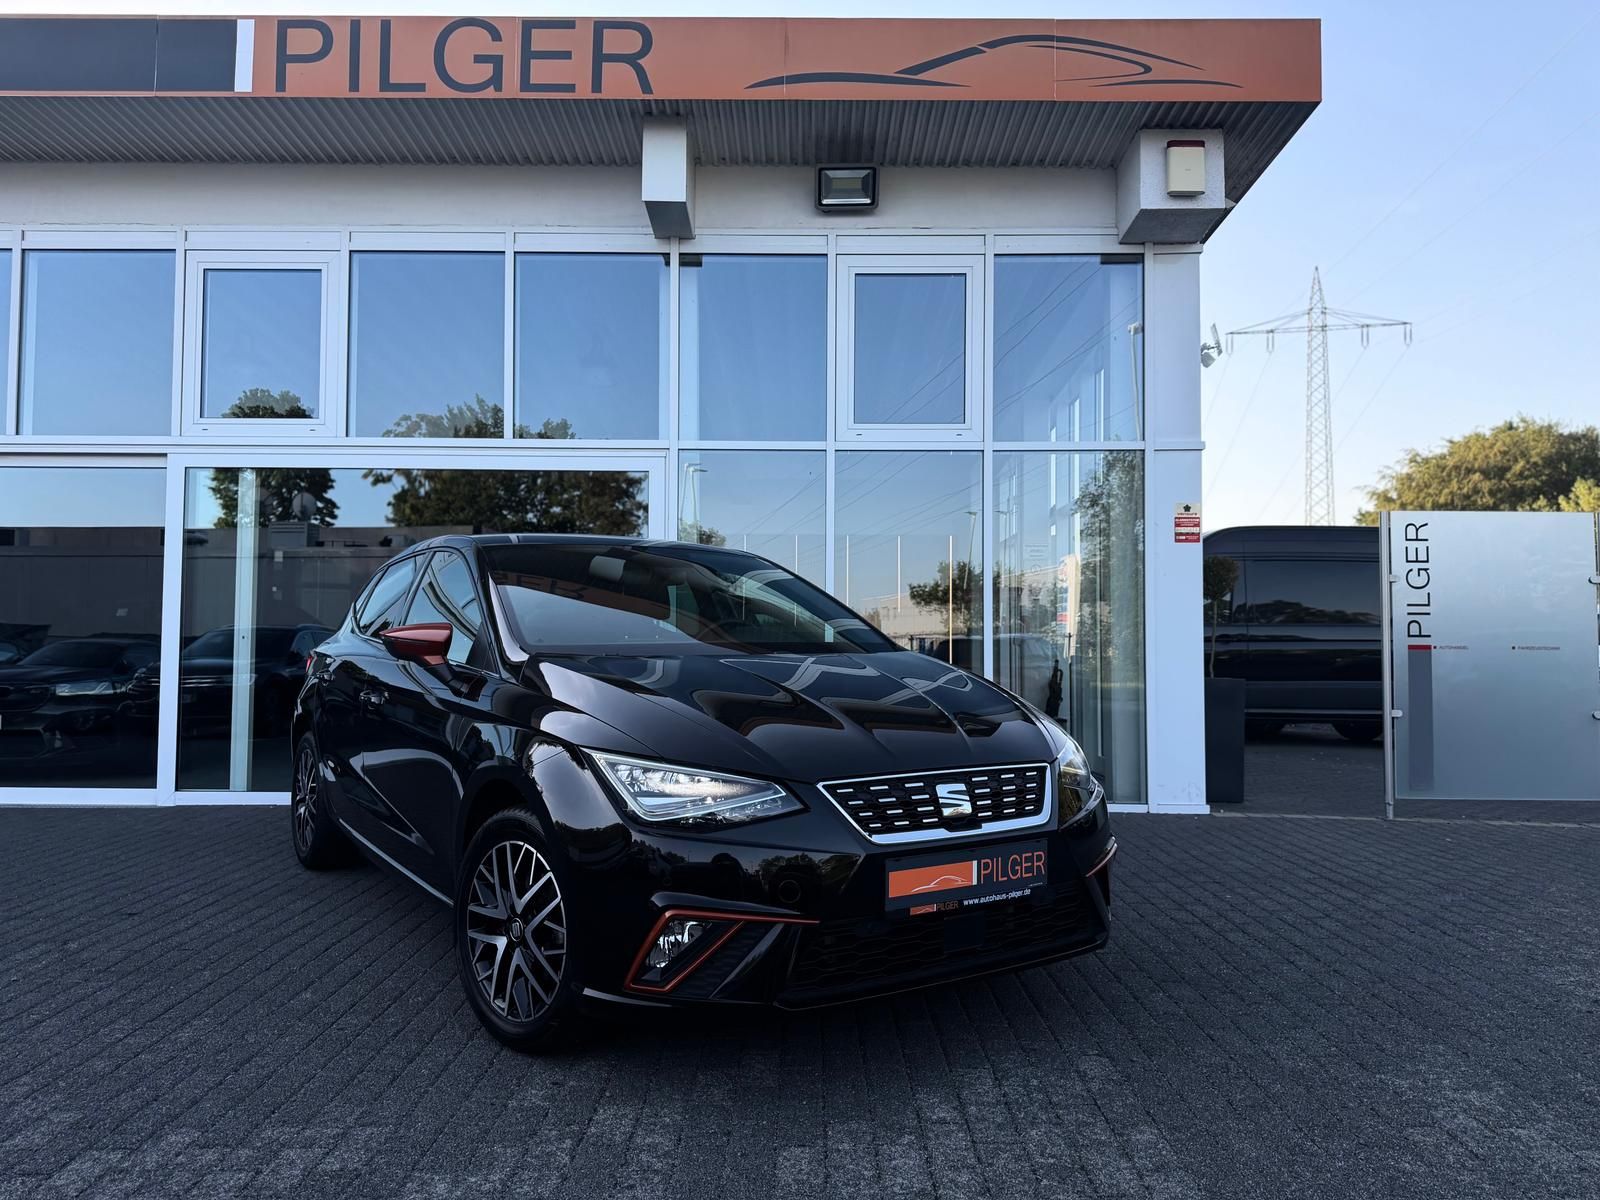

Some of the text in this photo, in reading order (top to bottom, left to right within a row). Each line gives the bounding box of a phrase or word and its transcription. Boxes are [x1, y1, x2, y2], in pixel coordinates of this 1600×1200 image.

[275, 17, 654, 95] PILGER
[1405, 522, 1431, 638] PILGER
[980, 851, 1045, 884] PILGER
[936, 900, 959, 912] PILGER
[963, 887, 1031, 906] www.autohaus-pilger.de
